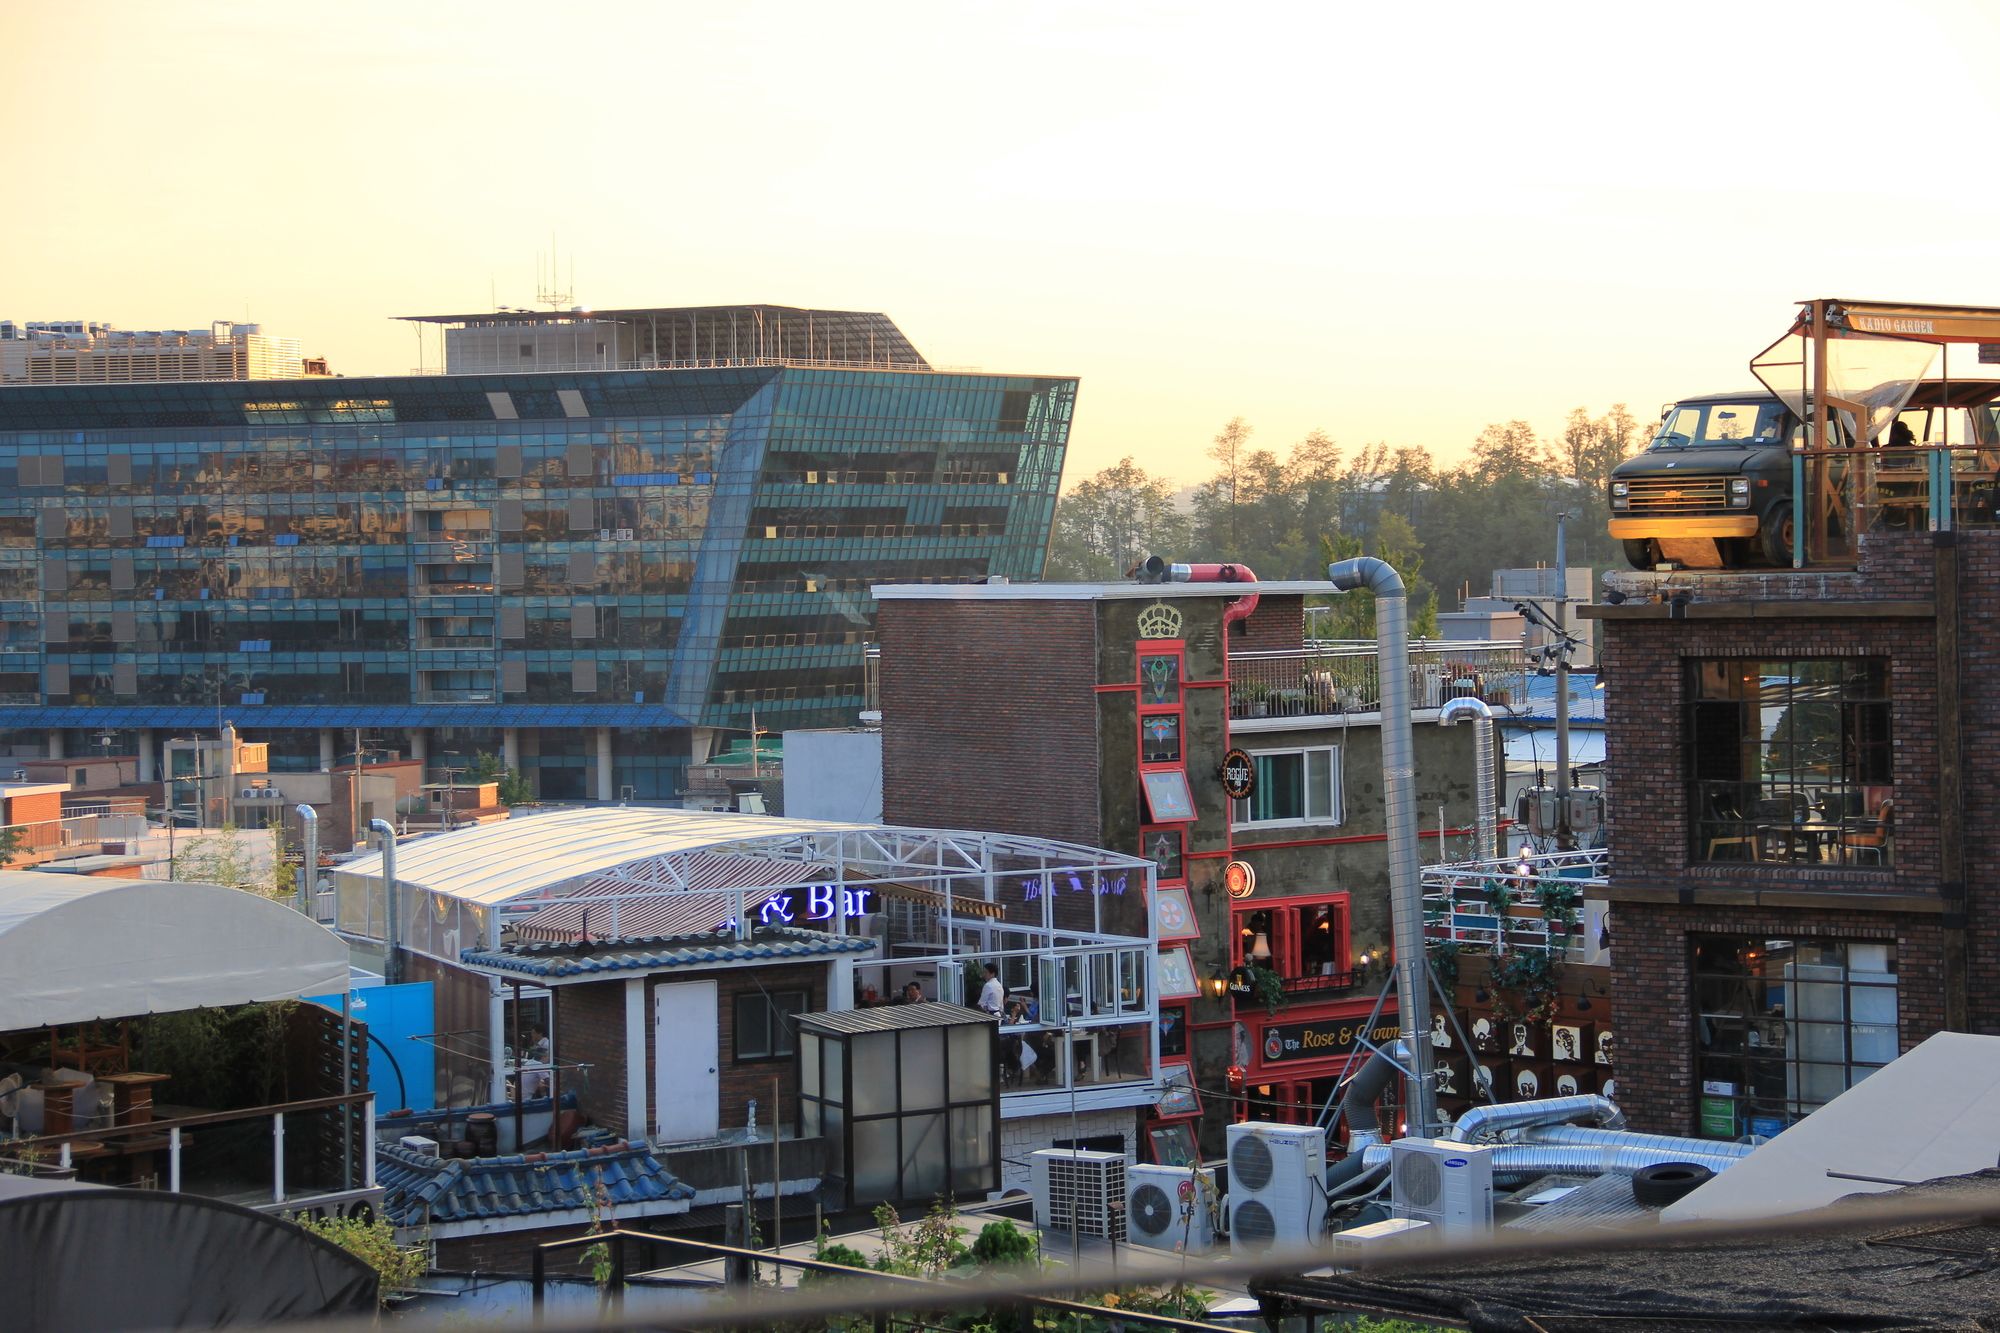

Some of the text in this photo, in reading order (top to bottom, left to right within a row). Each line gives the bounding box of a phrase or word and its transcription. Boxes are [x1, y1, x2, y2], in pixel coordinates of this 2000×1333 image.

[1860, 318, 1935, 334] RADIO GARDEN
[1226, 768, 1249, 781] ROGUE
[807, 885, 870, 920] Bar
[1285, 1024, 1402, 1050] The Rose & Cown
[1180, 1205, 1195, 1216] LG
